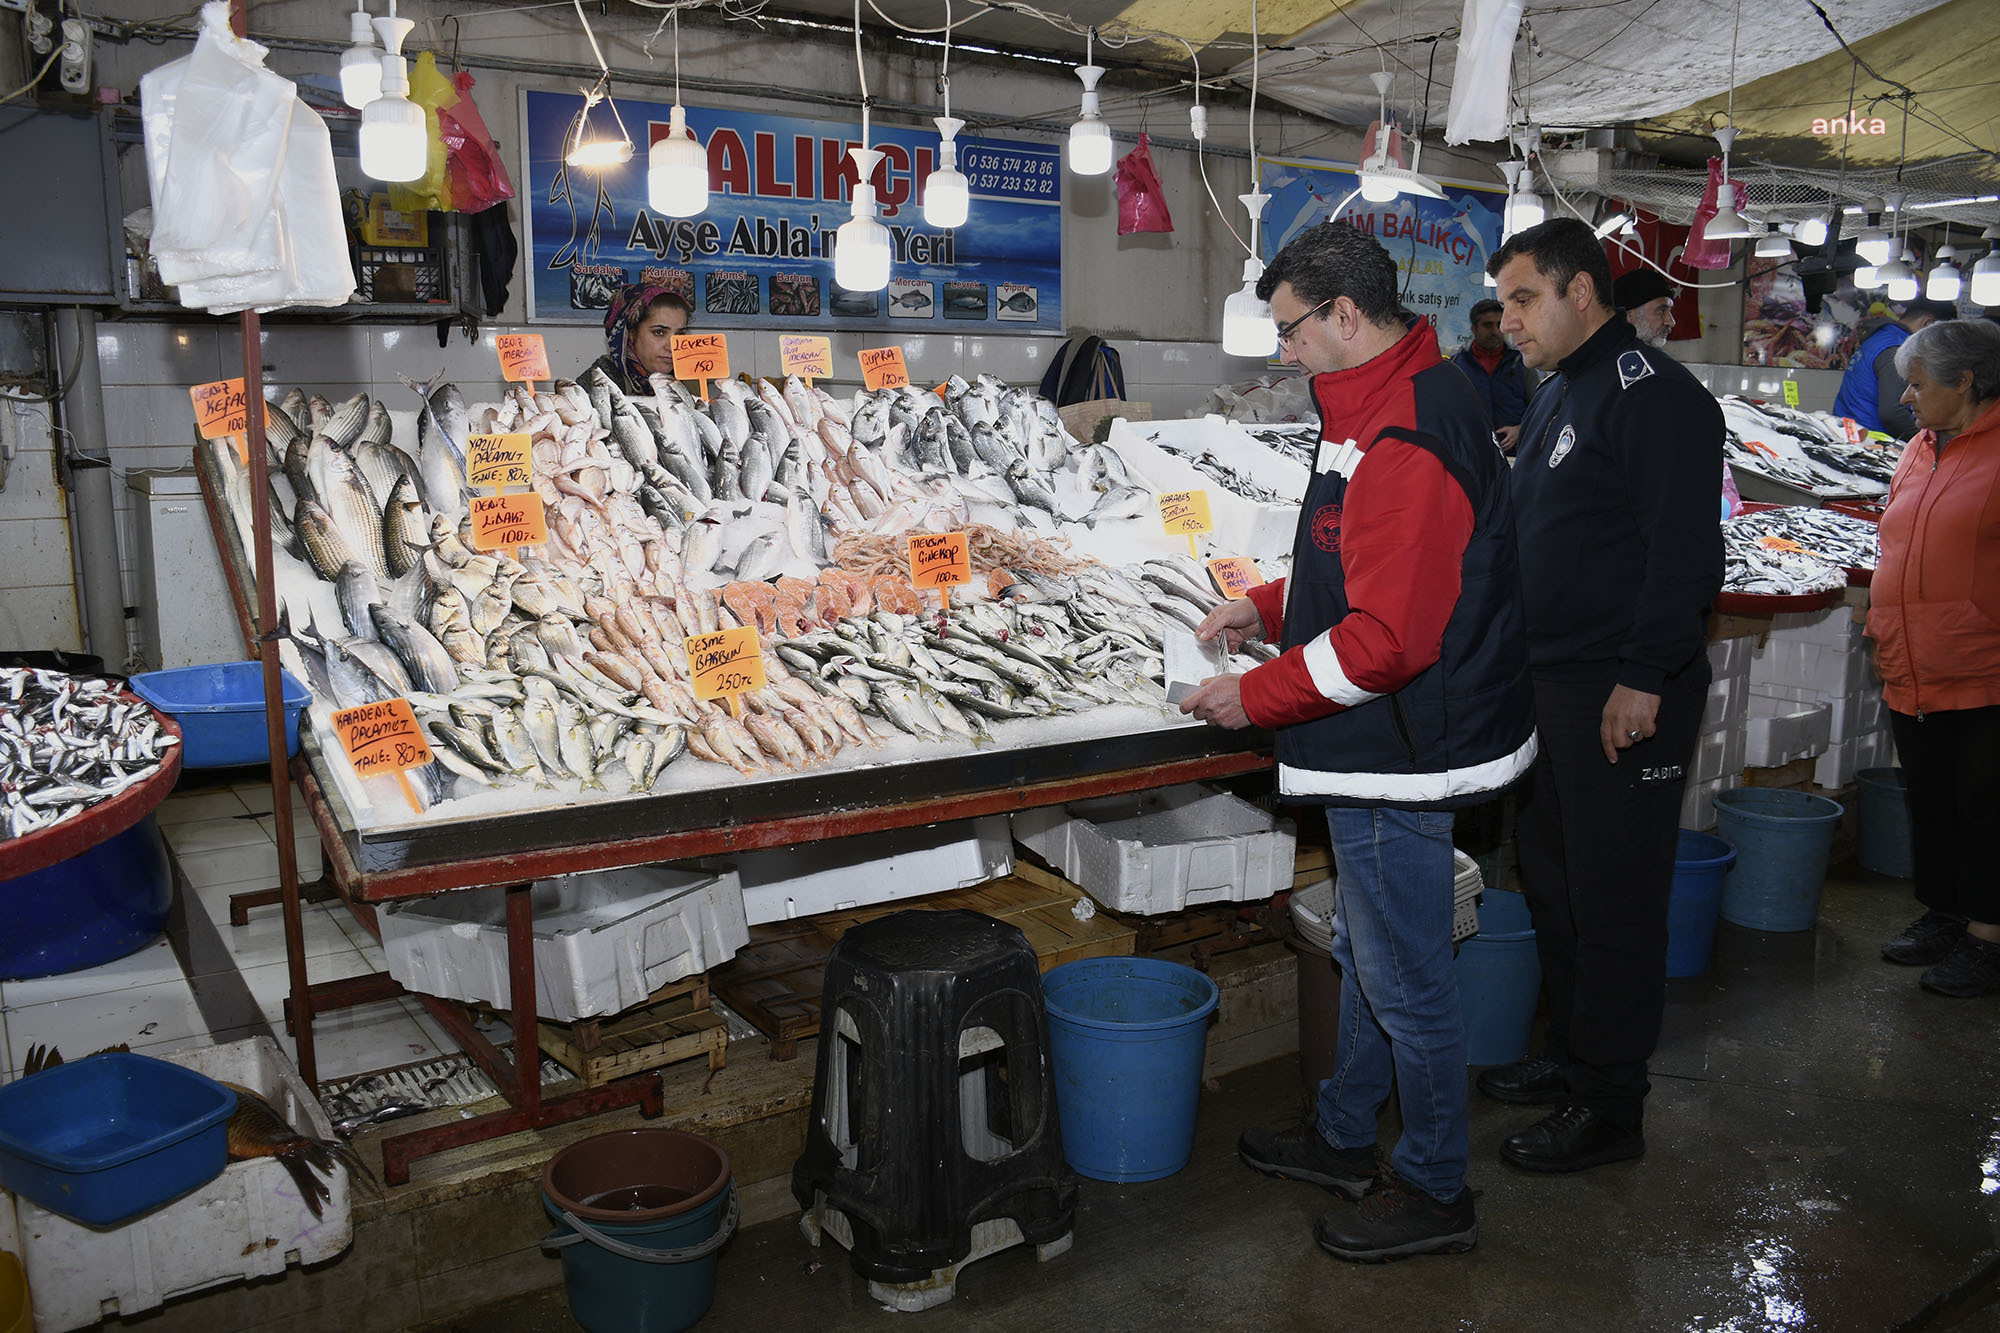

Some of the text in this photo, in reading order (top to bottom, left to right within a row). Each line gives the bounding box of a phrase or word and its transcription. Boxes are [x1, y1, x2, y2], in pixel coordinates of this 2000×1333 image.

[969, 154, 1053, 175] 0 536 574 28 86
[969, 173, 1053, 193] 0 537 233 52 82
[627, 208, 956, 266] Ayşe Abla'n Yeri
[1383, 213, 1475, 266] BALIKÇI
[573, 263, 622, 279] Sardalya
[646, 267, 686, 279] Karides
[715, 269, 748, 281] Hamsi
[894, 277, 927, 287] Mercan
[951, 280, 980, 289] Levrek
[1418, 292, 1442, 308] satış
[1444, 293, 1460, 309] yeri
[674, 336, 723, 351] LEVREK
[694, 360, 714, 373] 150
[695, 641, 744, 671] BARBUN
